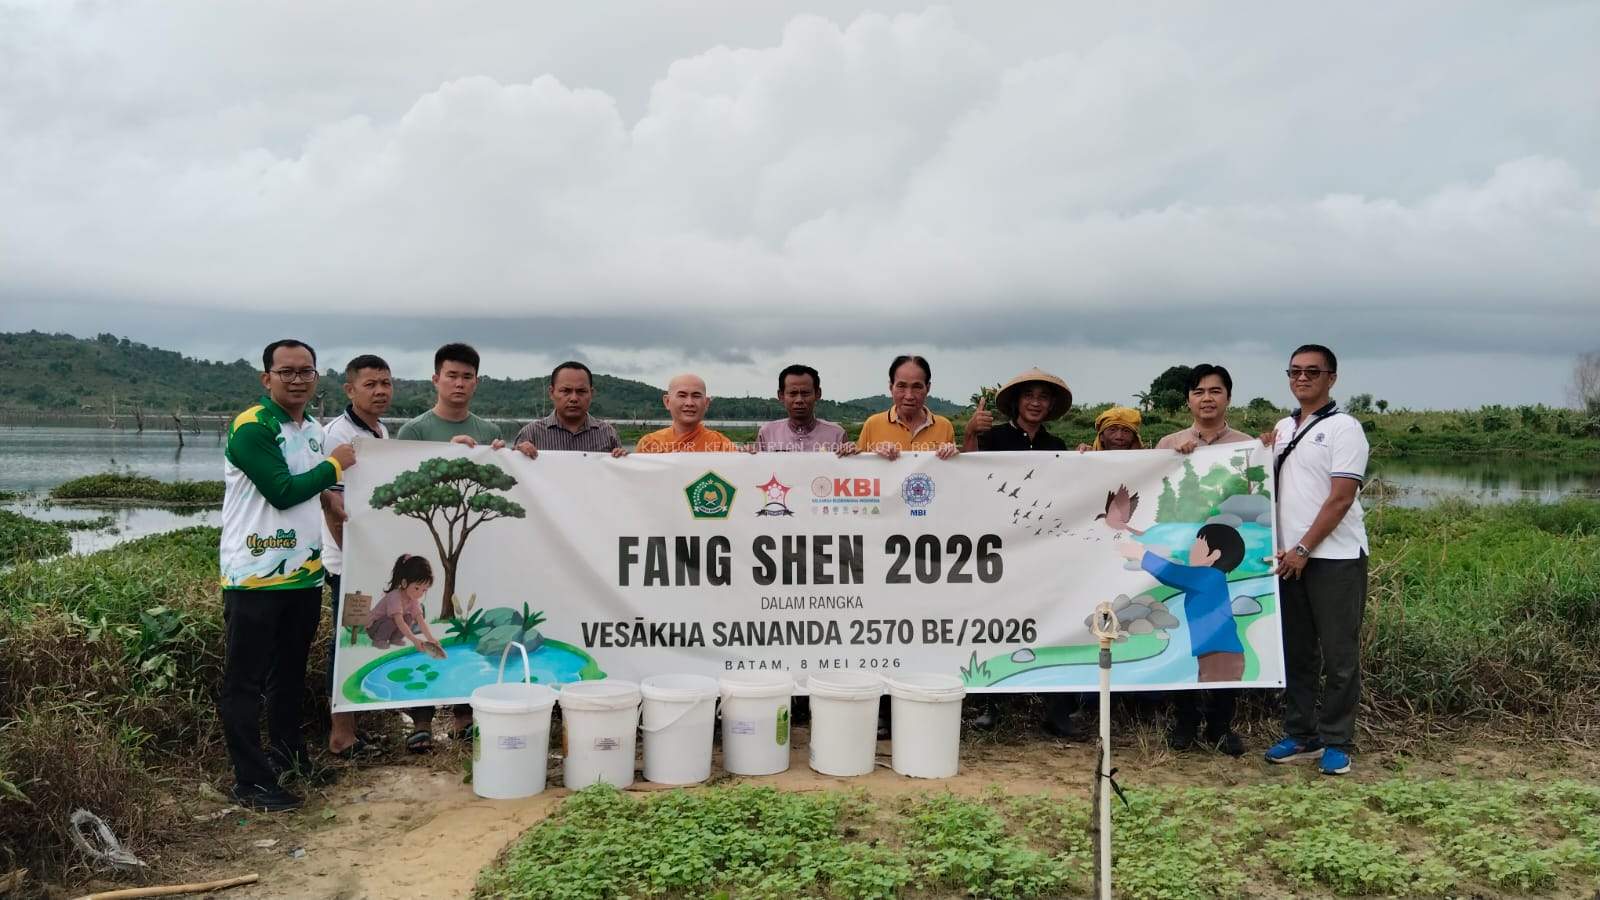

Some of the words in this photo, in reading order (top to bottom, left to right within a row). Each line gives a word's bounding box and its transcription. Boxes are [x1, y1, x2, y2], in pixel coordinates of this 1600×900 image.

[834, 478, 881, 497] KBI
[619, 536, 732, 586] FANG
[752, 535, 864, 586] SHEN
[885, 534, 1004, 584] 2026
[761, 596, 805, 610] DALAM
[809, 596, 864, 609] RANGKA
[582, 617, 706, 648] VESĀKHA
[712, 621, 842, 646] SANANDA
[850, 619, 914, 645] 2570
[922, 618, 1037, 647] BE/2026
[725, 660, 792, 672] BATAM,
[800, 660, 808, 670] 8
[820, 660, 849, 670] MEI
[859, 659, 902, 669] 2026
